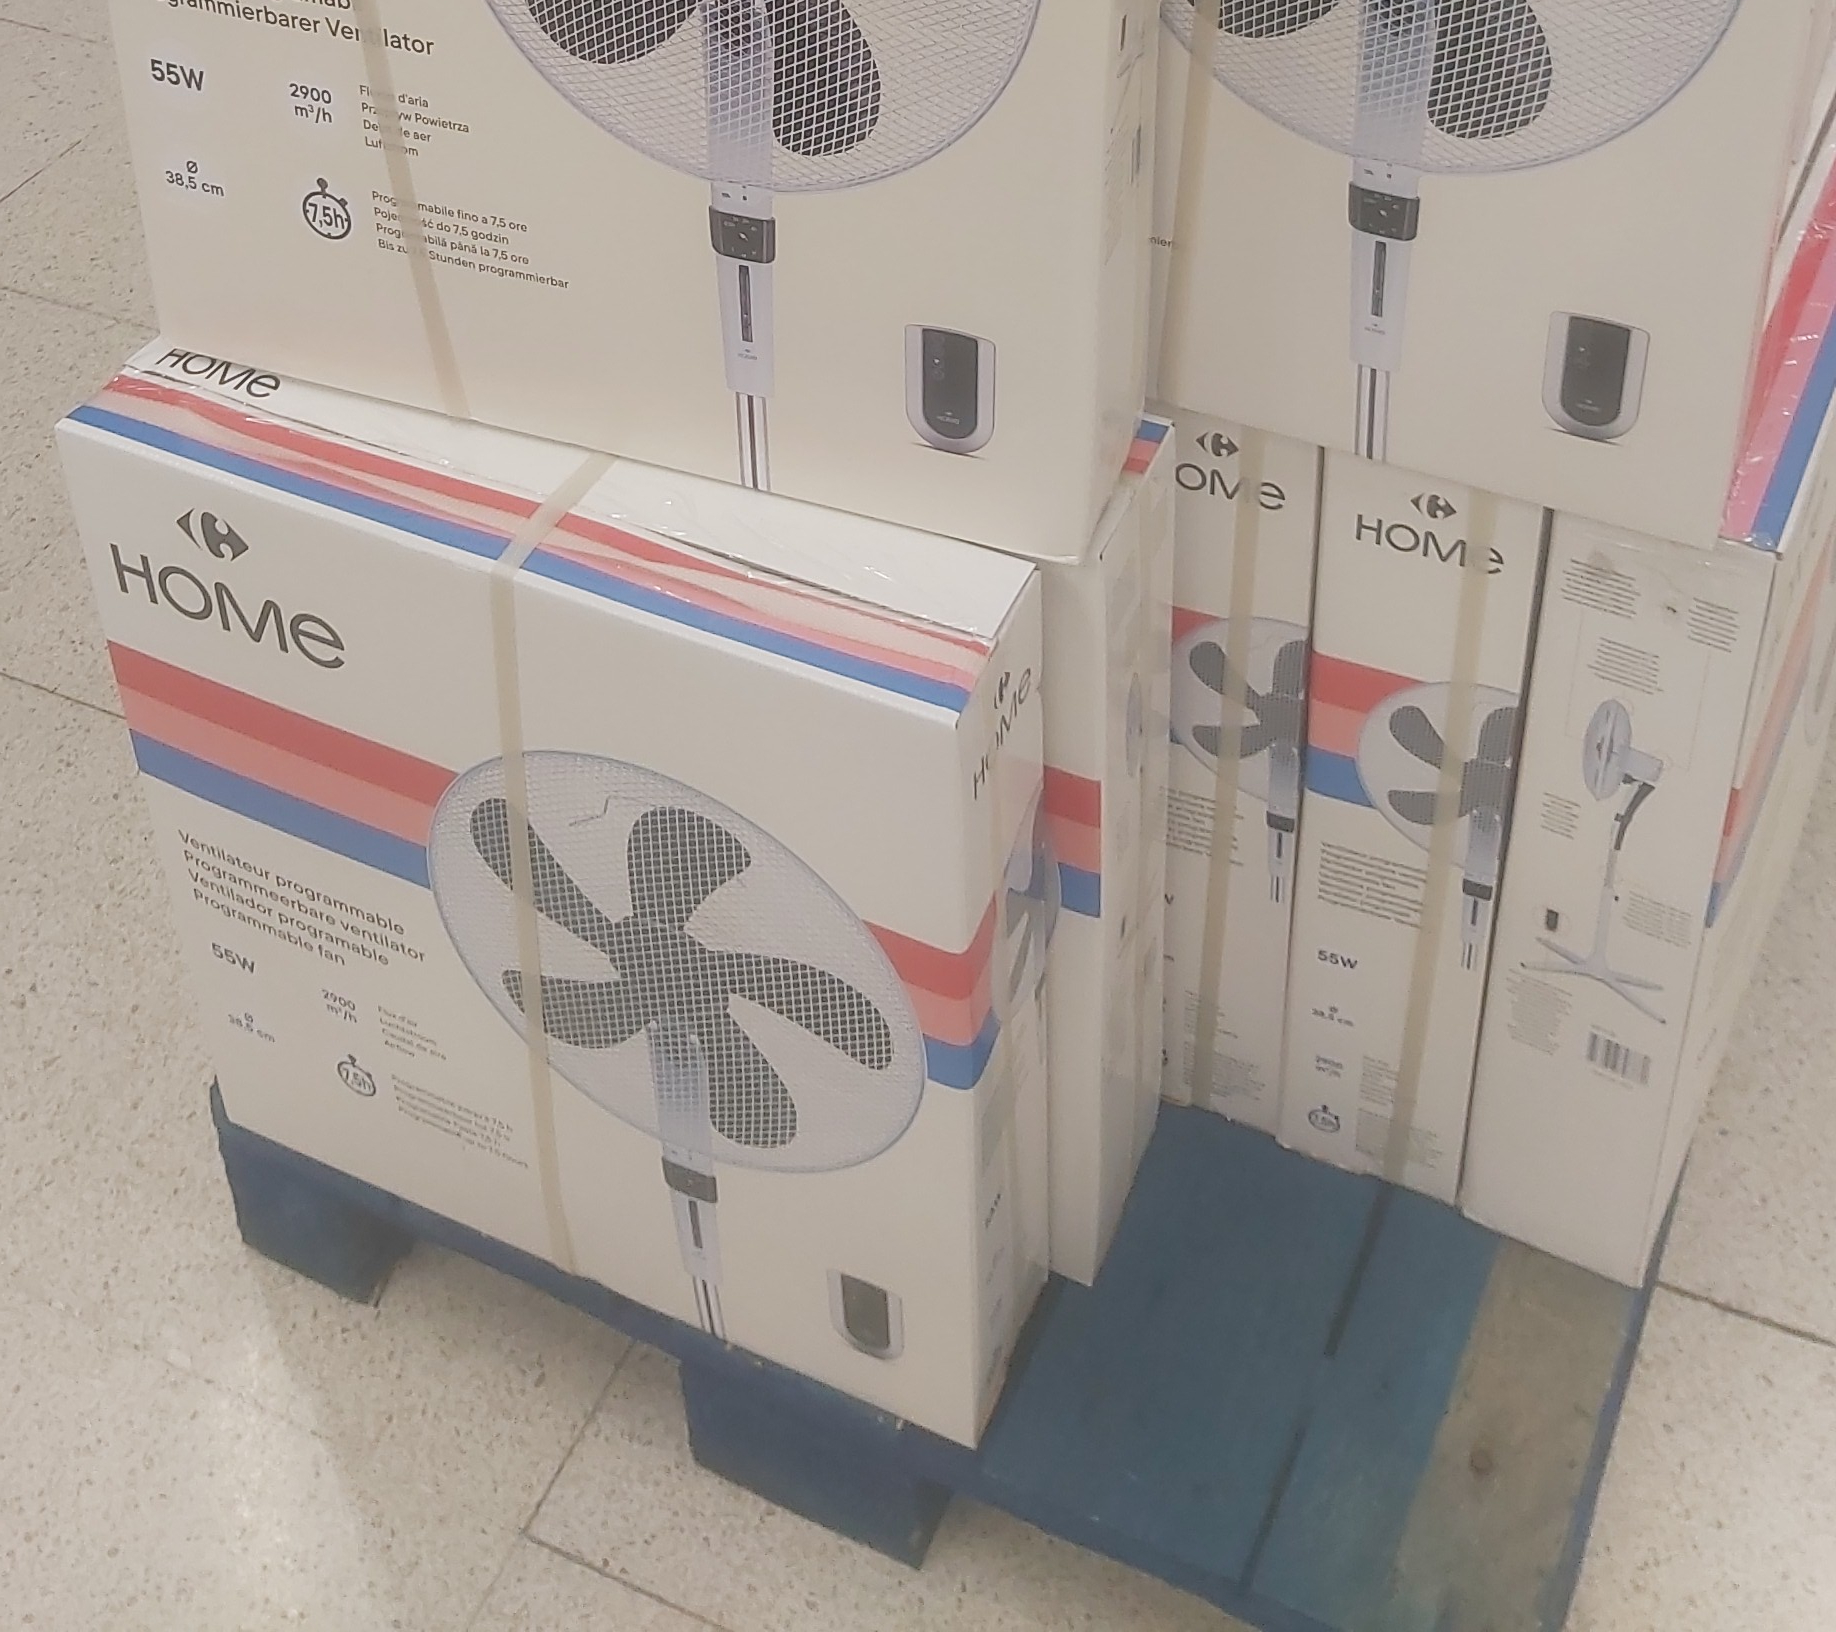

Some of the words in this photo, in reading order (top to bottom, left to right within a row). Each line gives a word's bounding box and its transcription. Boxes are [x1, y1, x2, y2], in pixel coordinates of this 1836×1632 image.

[150, 58, 205, 92] 55W
[289, 83, 333, 105] 2900
[413, 131, 432, 143] aer
[414, 113, 470, 134] Powietrza
[165, 171, 198, 190] 38,5
[201, 182, 225, 197] cm
[307, 202, 345, 230] 7,5h
[457, 207, 479, 223] fino
[490, 215, 507, 229] 7,5
[508, 223, 528, 233] ore
[436, 221, 451, 234] do
[452, 224, 469, 237] 7,5
[470, 230, 510, 246] godzin
[378, 238, 395, 252] Bis
[428, 249, 476, 269] Stunden
[478, 261, 570, 290] programmierbar
[480, 246, 491, 258] la
[492, 248, 509, 261] 7,5
[510, 254, 530, 266] ore
[178, 829, 271, 881] Ventilateur
[276, 874, 405, 935] programmable
[184, 849, 336, 926] Programmeerbare
[340, 919, 426, 963] ventilator
[188, 867, 273, 918] Ventilador
[278, 911, 390, 966] programable
[194, 887, 314, 953] Programmable
[318, 943, 347, 966] fan
[211, 941, 256, 974] 55W
[1317, 949, 1358, 969] 55W
